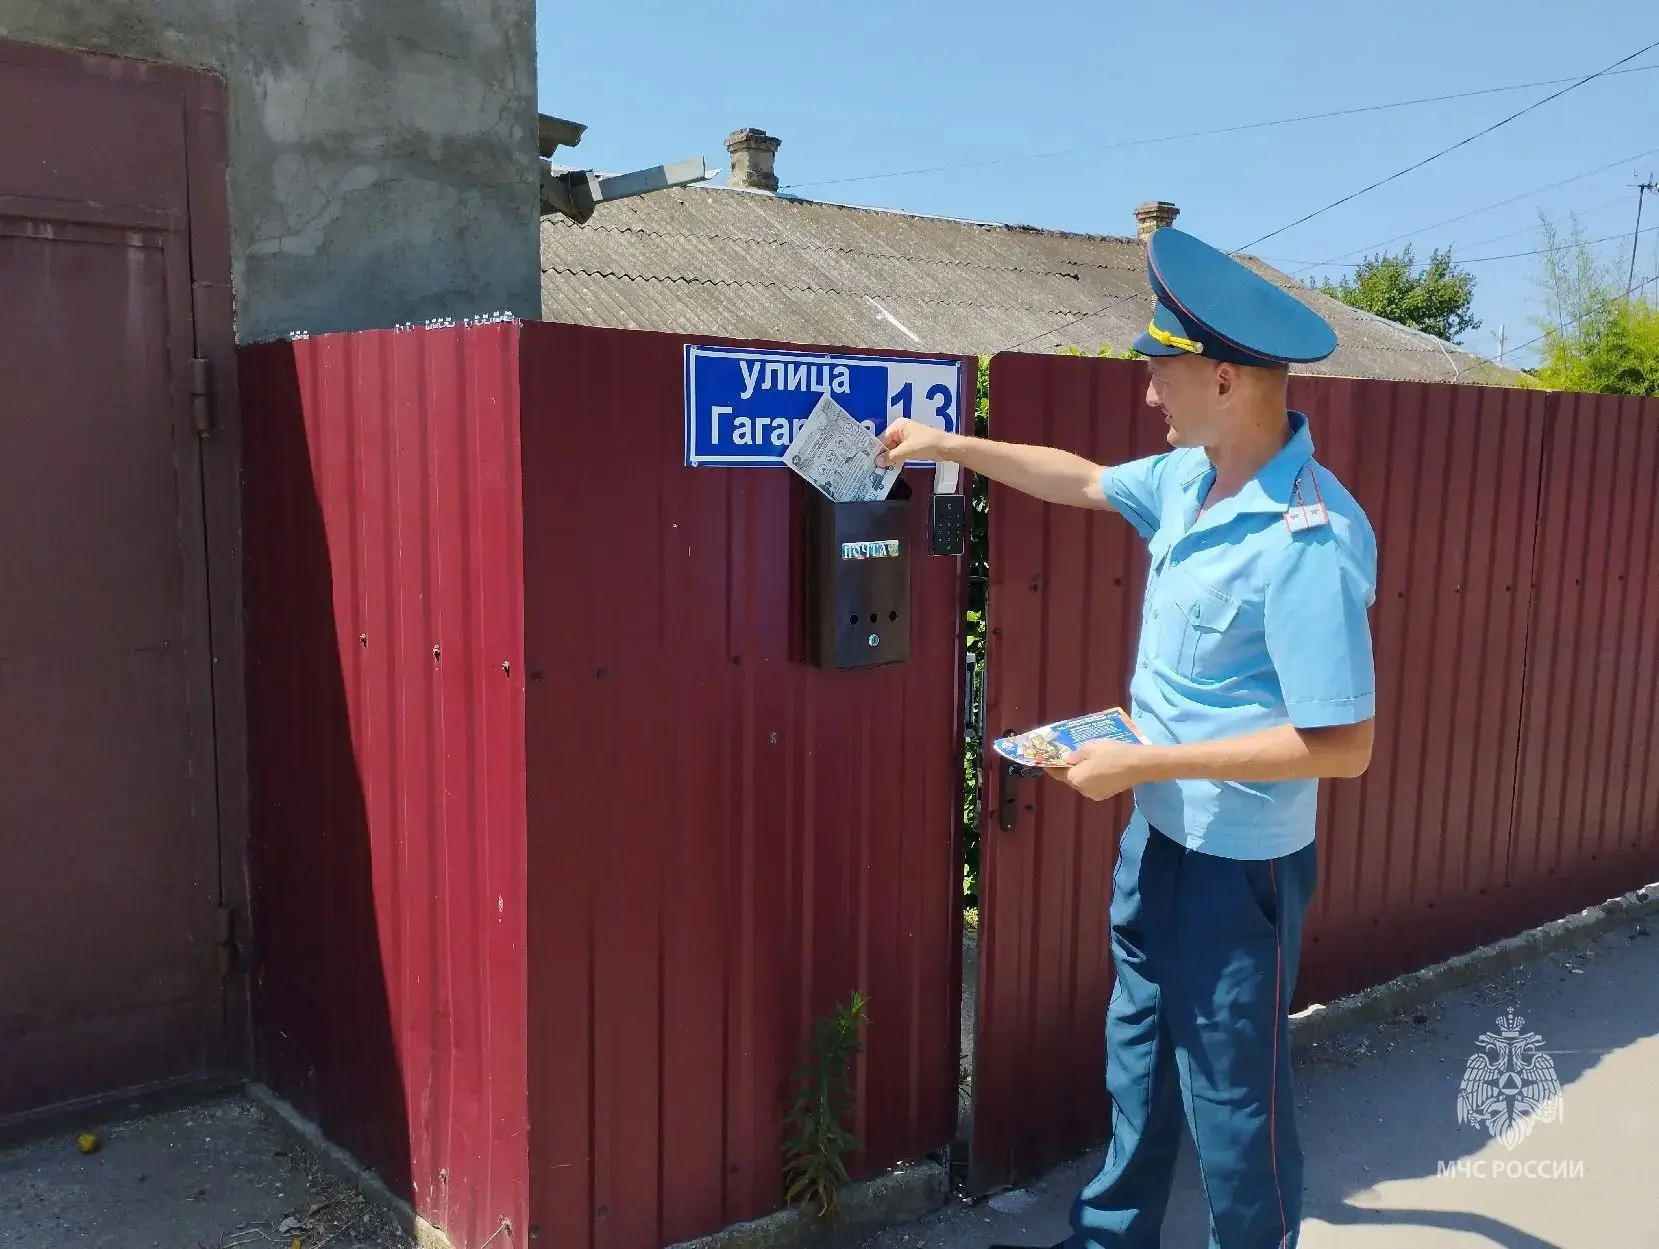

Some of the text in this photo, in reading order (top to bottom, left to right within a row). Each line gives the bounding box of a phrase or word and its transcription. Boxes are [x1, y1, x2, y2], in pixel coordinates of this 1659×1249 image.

[739, 360, 851, 399] улица
[711, 405, 876, 446] Гага
[890, 382, 954, 433] 13
